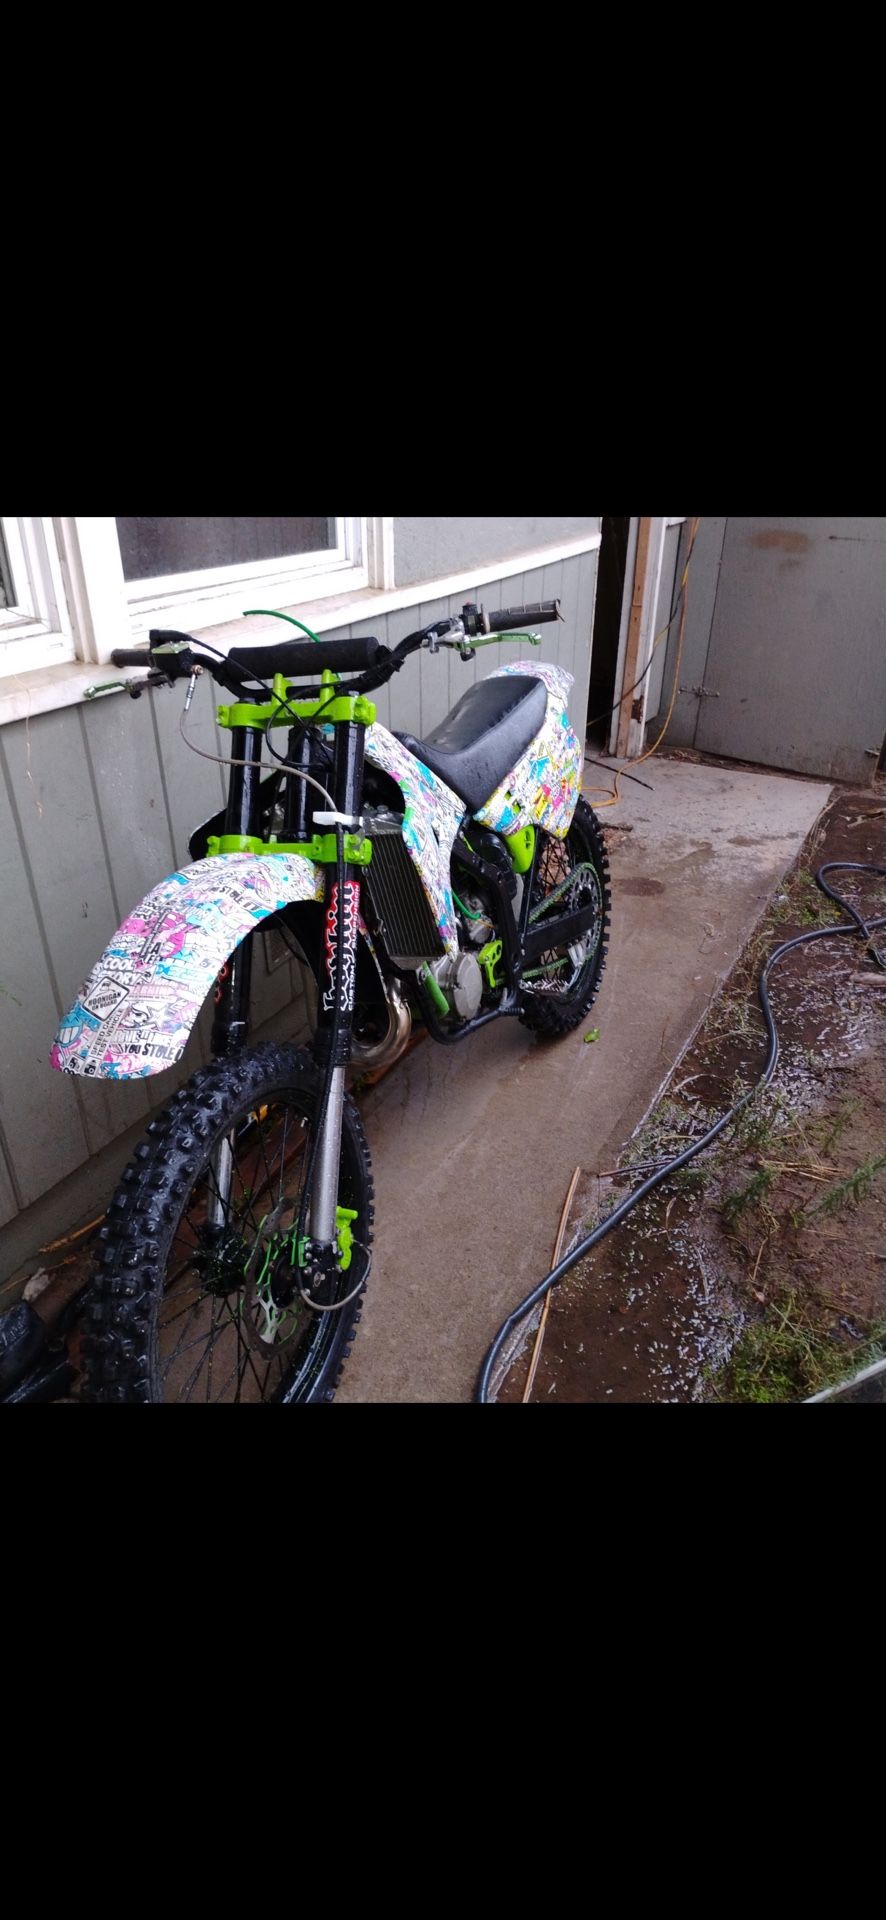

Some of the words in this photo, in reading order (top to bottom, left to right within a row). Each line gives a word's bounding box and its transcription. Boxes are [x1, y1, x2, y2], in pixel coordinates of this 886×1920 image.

[351, 884, 360, 950] SUSPENSION
[103, 957, 134, 971] COOL
[88, 992, 121, 1007] HOONIGAN
[97, 1039, 109, 1057] TEST
[106, 1008, 123, 1037] VEHICLE
[124, 1043, 141, 1054] YOU
[142, 1043, 175, 1060] STOLE
